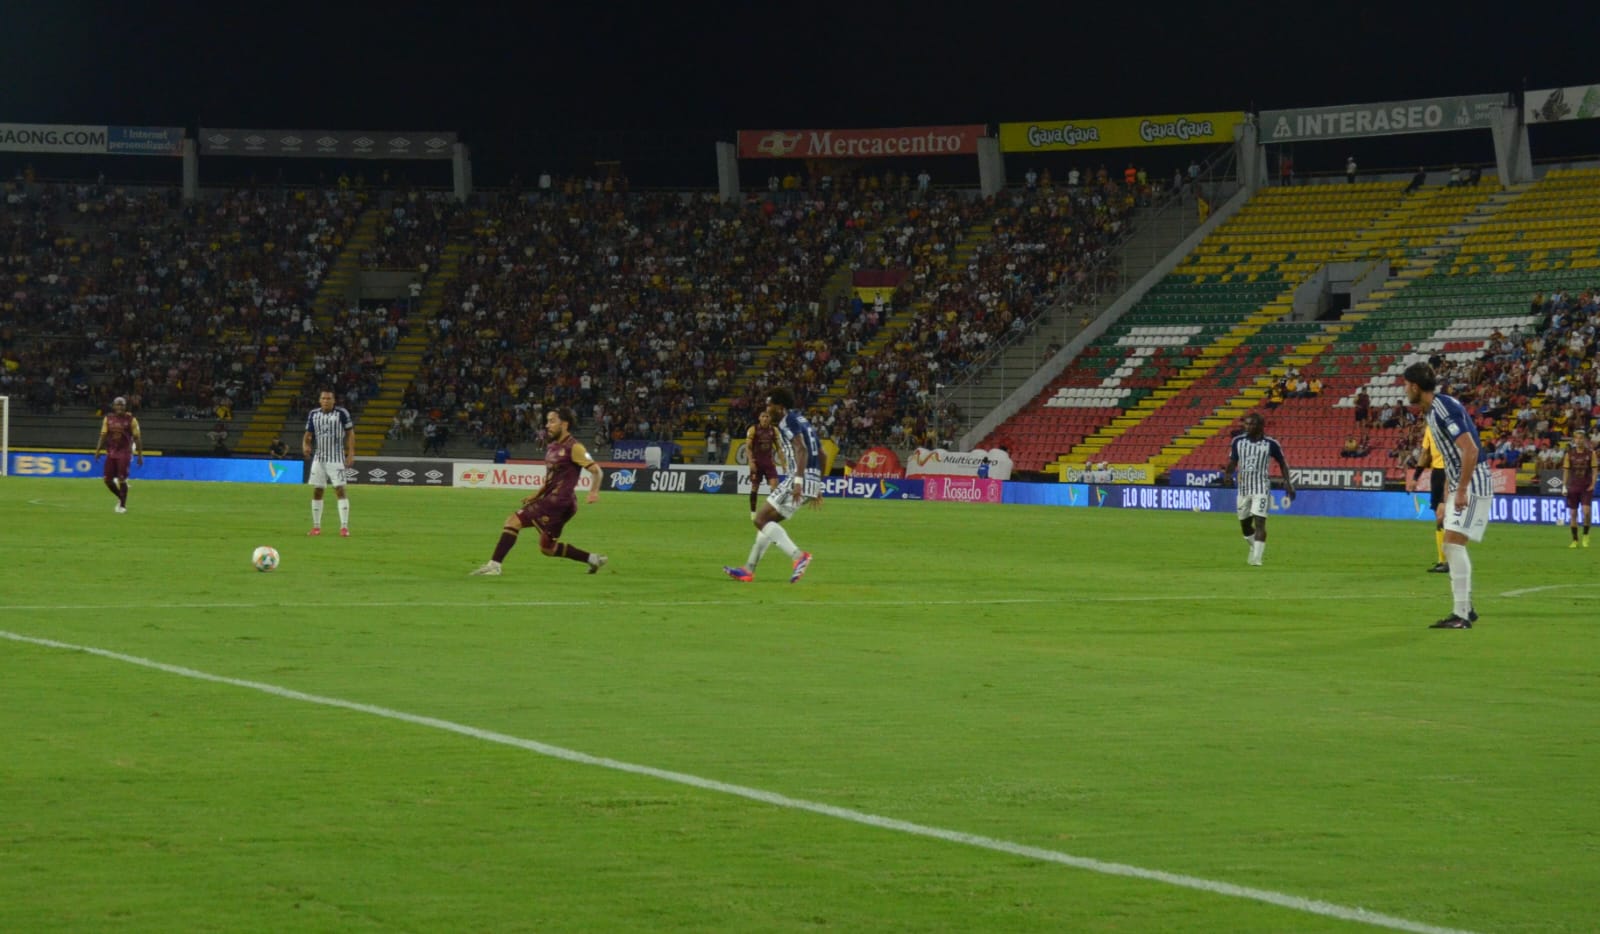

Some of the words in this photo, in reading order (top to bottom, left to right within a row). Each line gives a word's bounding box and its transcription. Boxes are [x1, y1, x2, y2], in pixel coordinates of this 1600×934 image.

[1297, 104, 1442, 136] INTERASEO
[808, 132, 961, 156] Mercacentro
[613, 448, 646, 460] BetPl
[610, 468, 637, 488] Pool
[650, 470, 687, 491] SODA
[699, 472, 725, 490] Pool
[820, 478, 876, 499] etPlay
[943, 477, 982, 500] Rosado
[1140, 488, 1159, 508] QUE
[1161, 489, 1211, 511] RECARGAS
[1260, 498, 1266, 509] 8
[1512, 498, 1537, 522] QUE
